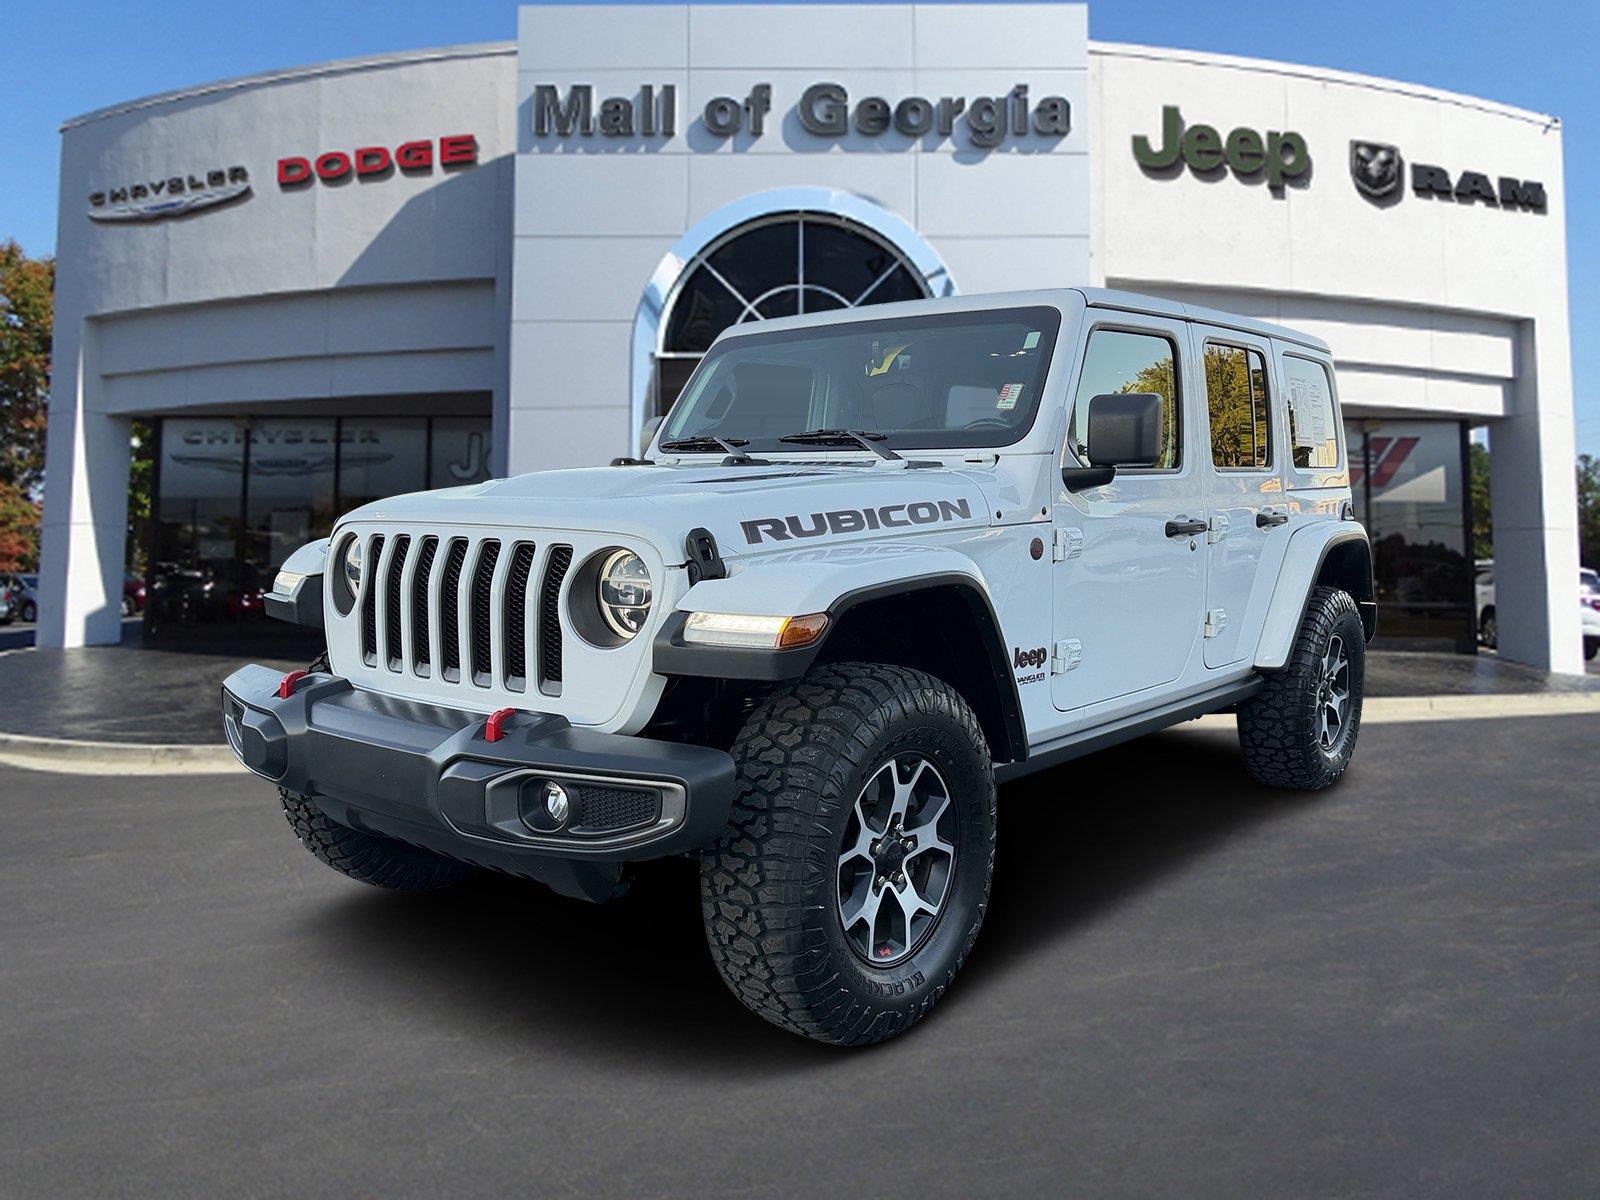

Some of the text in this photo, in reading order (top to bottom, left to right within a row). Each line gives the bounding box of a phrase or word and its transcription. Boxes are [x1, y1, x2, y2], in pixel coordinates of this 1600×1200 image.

[534, 82, 1071, 147] Mall of Georgia
[277, 134, 476, 186] DODGE
[1132, 105, 1309, 190] Jeep
[89, 166, 248, 206] CHRYSLER
[1411, 163, 1546, 212] RAM
[740, 498, 972, 545] RUBICON
[1013, 647, 1047, 669] Jeep
